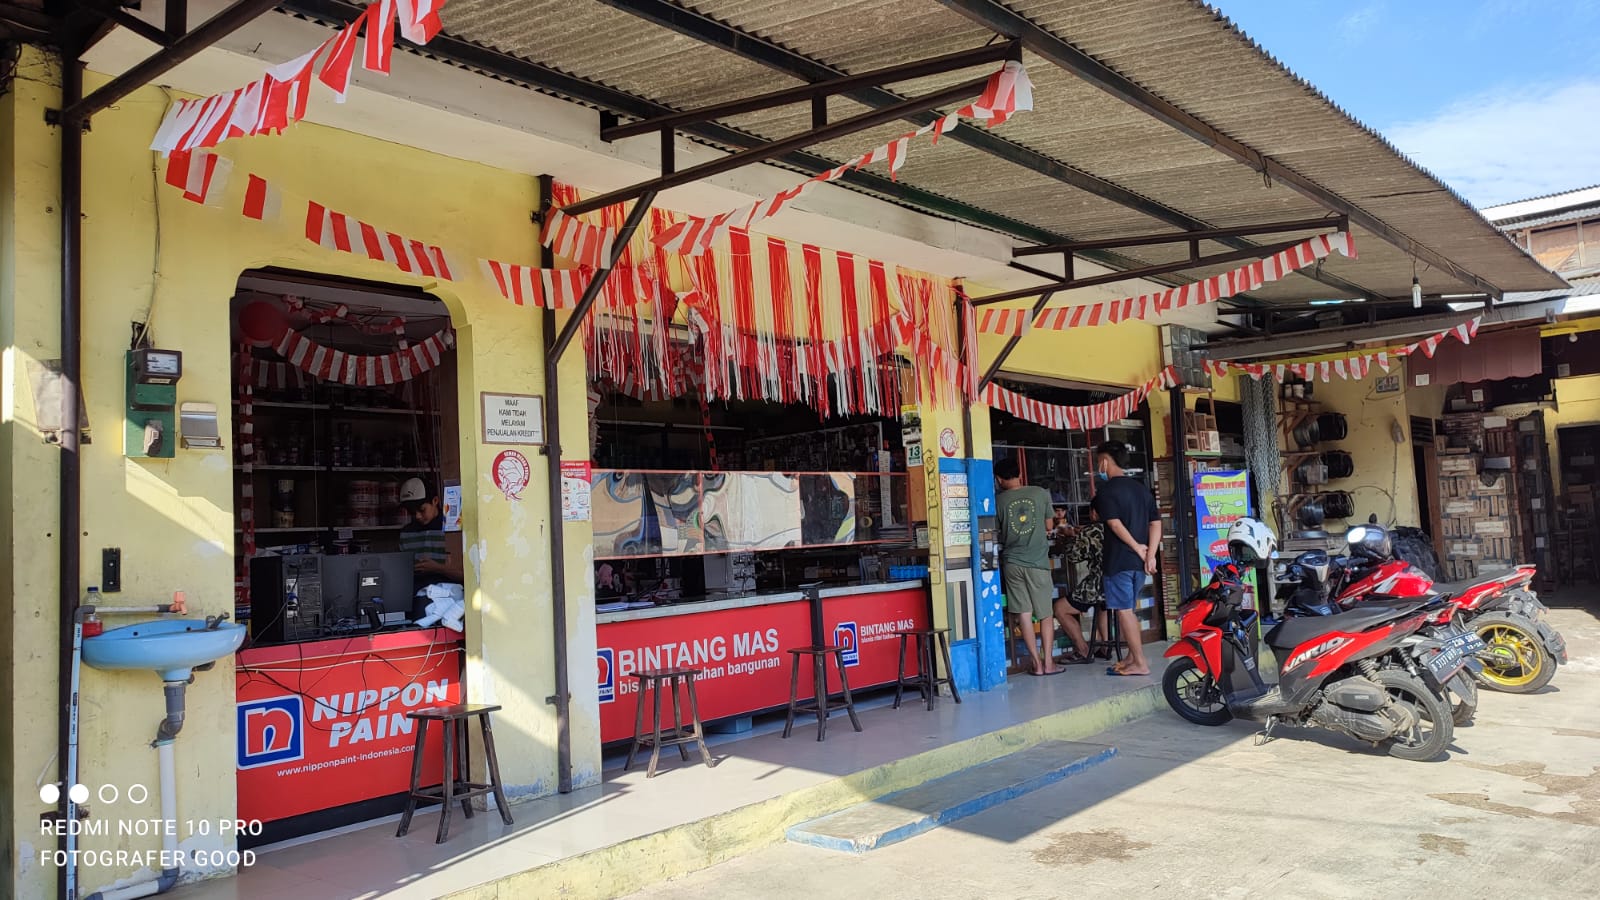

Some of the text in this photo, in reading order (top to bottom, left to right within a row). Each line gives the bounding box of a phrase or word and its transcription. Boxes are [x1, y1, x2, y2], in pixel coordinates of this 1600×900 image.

[487, 428, 517, 437] PENJUALAN
[908, 446, 920, 457] 13
[861, 619, 914, 636] BINTANG MAS
[618, 628, 779, 677] BINTANG MAS
[727, 655, 780, 676] bangunan
[312, 678, 449, 723] NIPPON
[328, 706, 436, 748] PAIN
